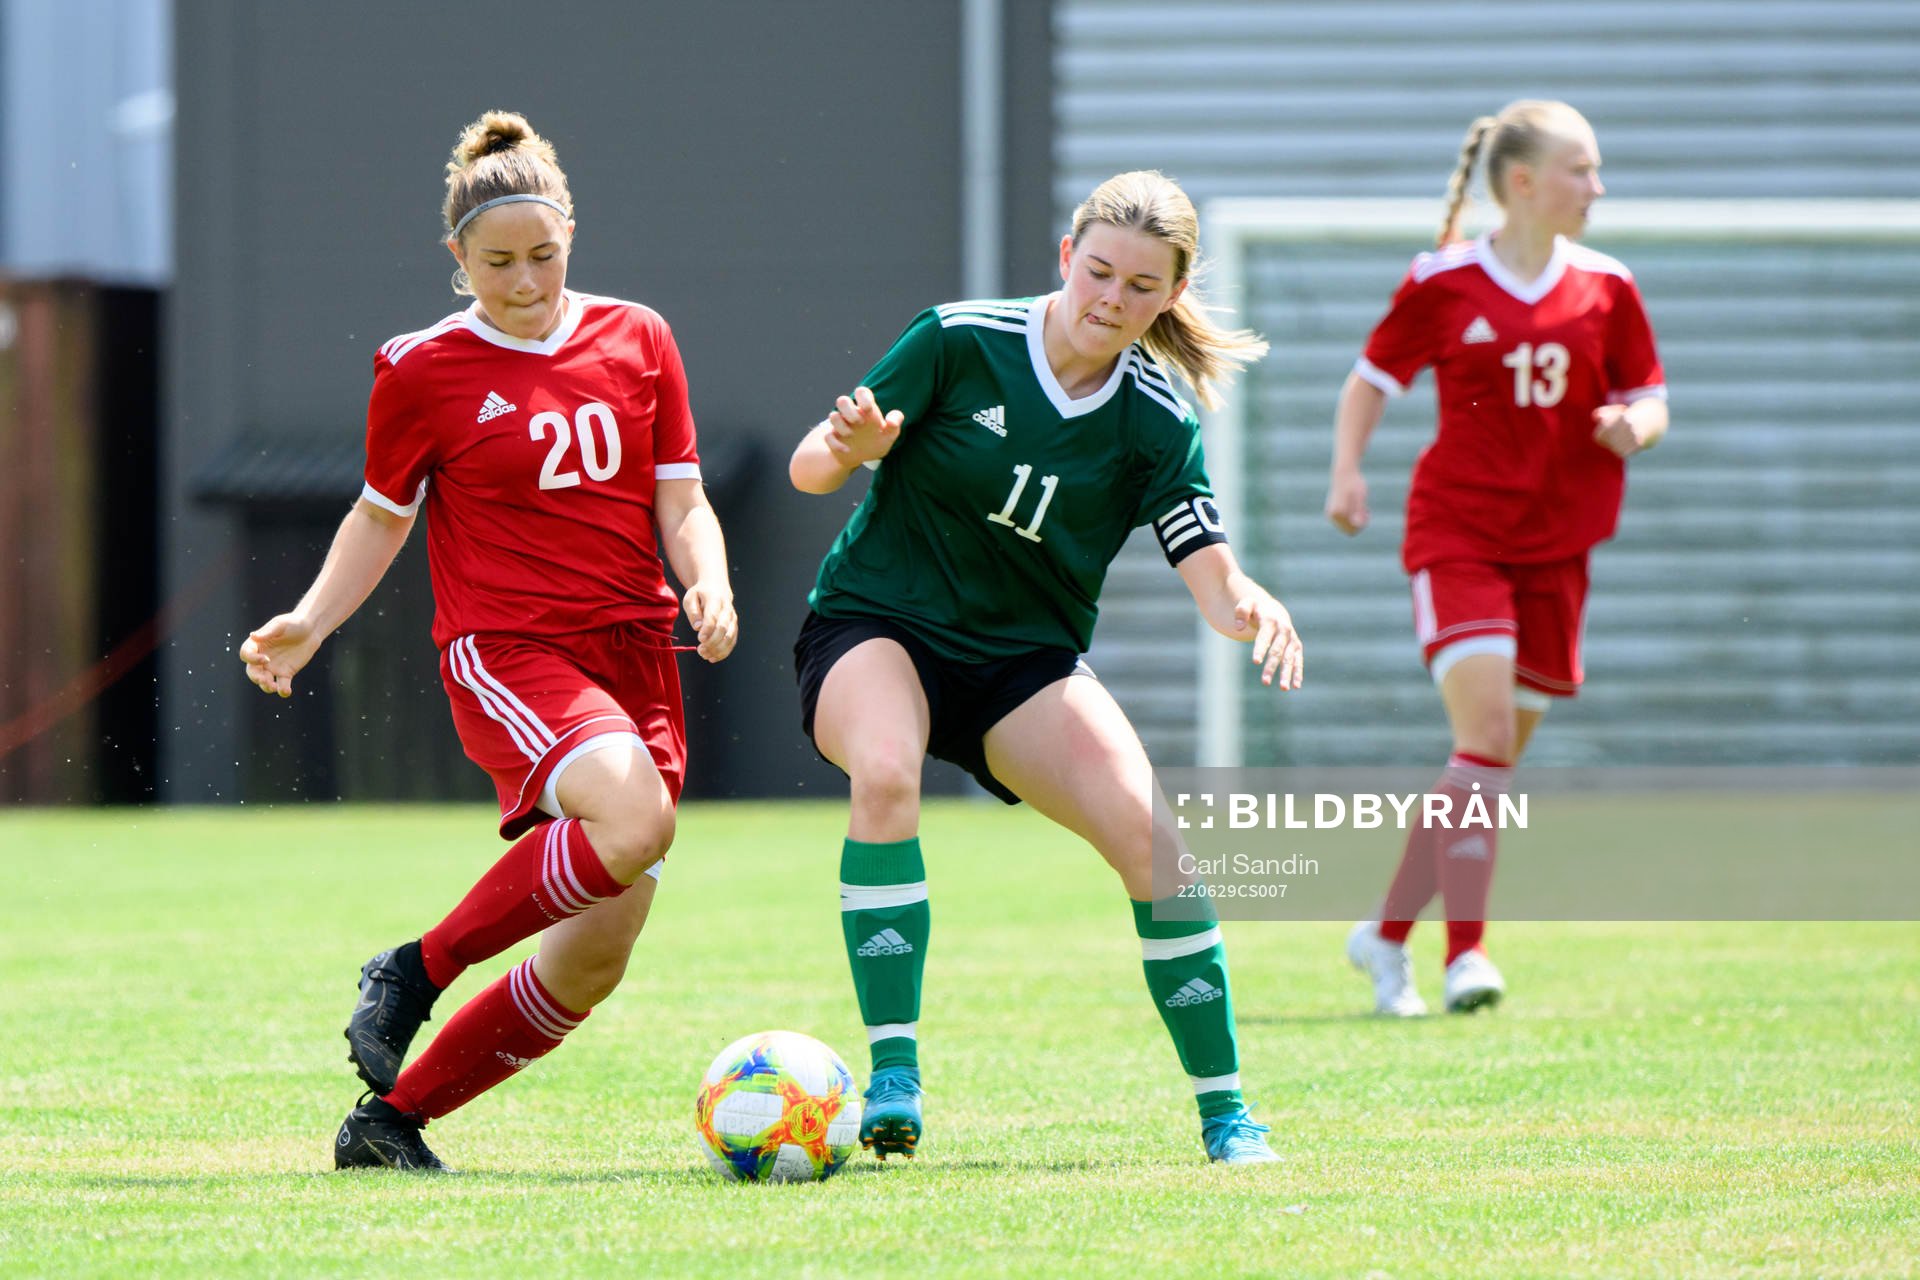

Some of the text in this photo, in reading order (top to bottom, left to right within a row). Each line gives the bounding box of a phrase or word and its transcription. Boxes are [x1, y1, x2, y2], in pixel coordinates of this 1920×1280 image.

[1502, 342, 1571, 408] 13
[477, 403, 517, 424] adidas
[972, 413, 1008, 437] adidas
[529, 402, 621, 490] 20
[987, 464, 1059, 543] 11
[857, 943, 914, 957] adidas
[1165, 988, 1223, 1007] adidas
